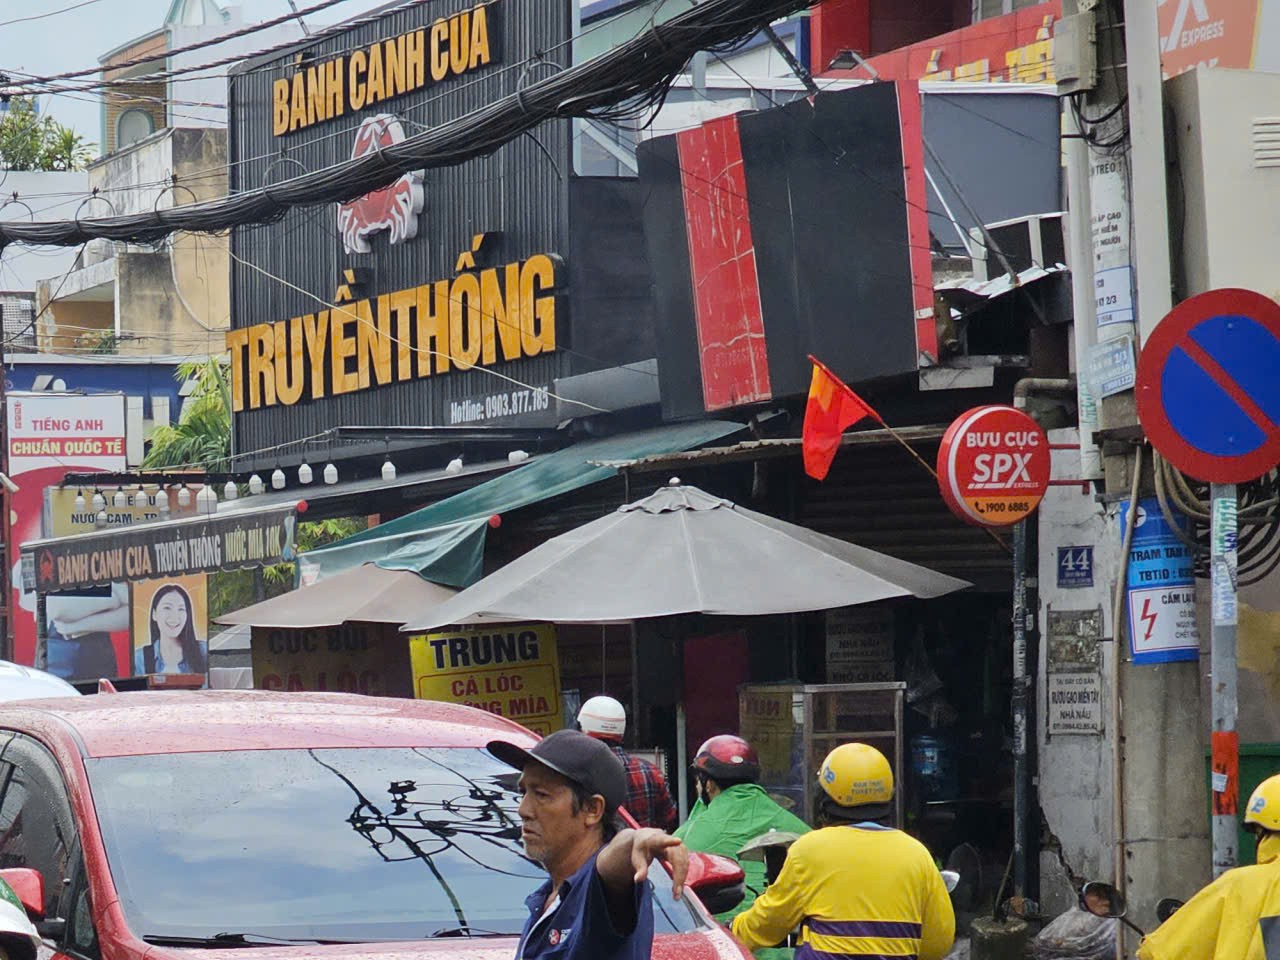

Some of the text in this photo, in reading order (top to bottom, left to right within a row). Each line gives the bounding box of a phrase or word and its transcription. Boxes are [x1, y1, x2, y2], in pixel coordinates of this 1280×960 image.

[1181, 19, 1225, 48] EXPRESS
[273, 6, 490, 137] BÁNH CANH CUA
[450, 386, 549, 424] Hotline: 0903.877.185
[31, 417, 104, 431] TIẾNG ANH
[64, 436, 103, 455] QUỐC
[105, 435, 122, 454] TẾ
[966, 431, 1039, 450] BƯU CỤC
[972, 452, 1033, 488] SPX
[71, 511, 101, 524] NƯỚ
[107, 513, 133, 524] CAM
[985, 502, 1006, 513] 1900
[57, 549, 88, 585] BÁNH
[91, 546, 122, 581] CANH
[125, 544, 153, 577] CUA
[154, 529, 188, 573] TRUYỀN
[190, 526, 221, 568] THỐNG
[225, 528, 247, 562] NƯỚC
[248, 526, 265, 559] MÍA
[266, 525, 281, 556] 10K
[1061, 548, 1090, 570] 44
[452, 671, 524, 696] CÁ LÓC
[508, 693, 550, 716] MÍA
